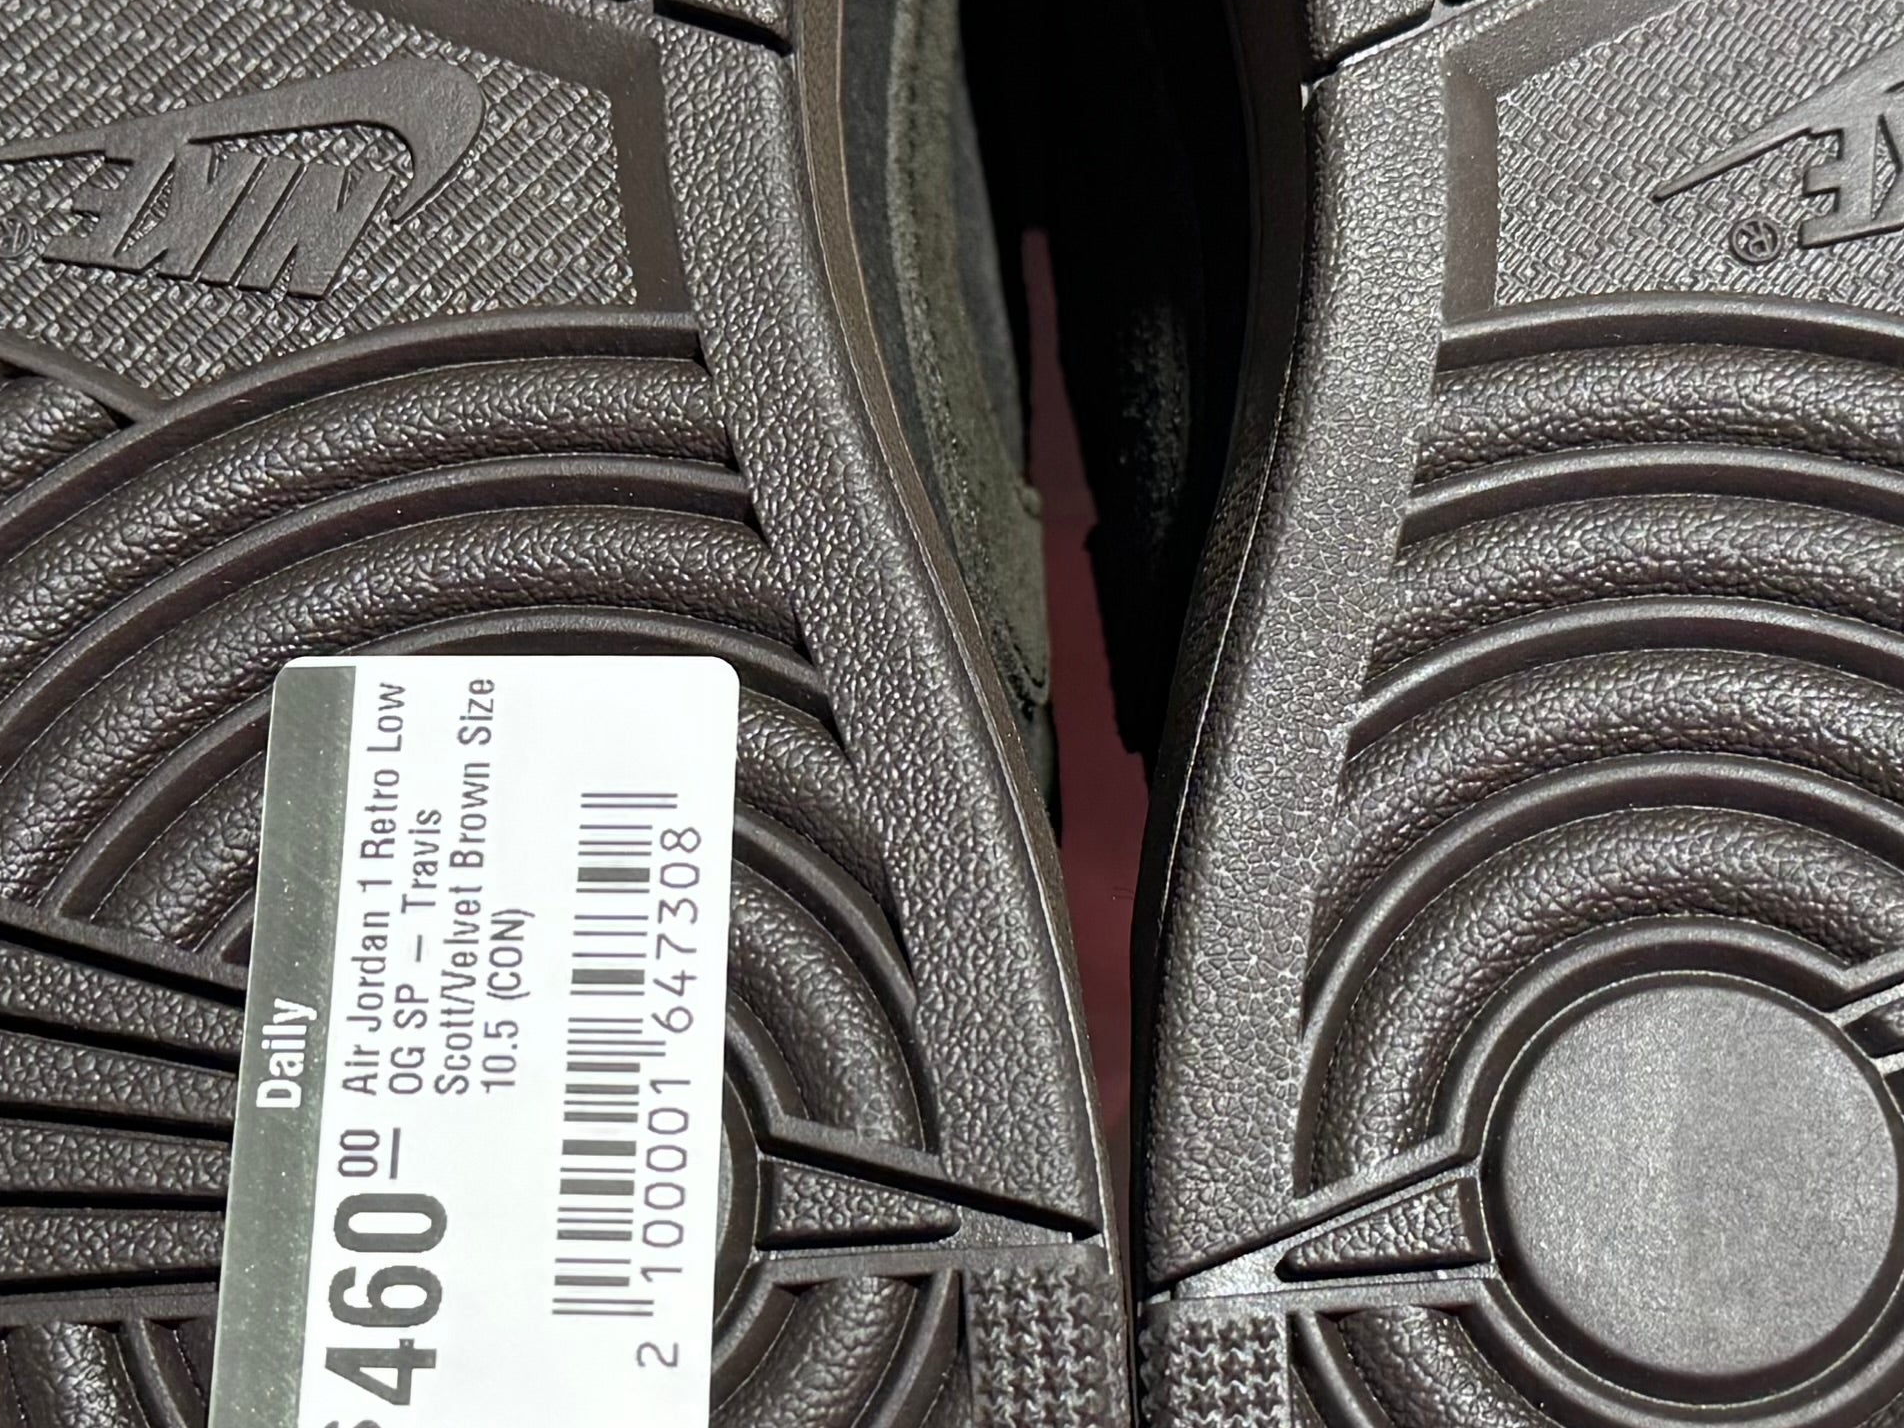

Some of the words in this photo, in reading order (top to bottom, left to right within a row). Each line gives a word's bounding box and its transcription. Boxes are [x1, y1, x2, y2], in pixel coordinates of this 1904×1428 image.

[42, 144, 396, 302] NIKE
[366, 681, 406, 752] Low
[457, 677, 496, 746] Size
[360, 768, 401, 860] Retro
[449, 761, 491, 870] Brown
[356, 878, 393, 893] 1
[400, 807, 443, 914] Travis
[346, 910, 391, 1032] Jordan
[486, 907, 536, 1002] (CON)
[651, 824, 703, 1036] 647308
[394, 982, 430, 1030] SP
[434, 884, 483, 1096] Scott/Velvet
[256, 997, 318, 1109] Daily
[342, 1047, 381, 1097] Air
[388, 1046, 426, 1096] OG
[479, 1018, 521, 1095] 10.5
[337, 1128, 381, 1178] 00
[639, 1079, 693, 1284] 100001
[636, 1340, 680, 1369] 2
